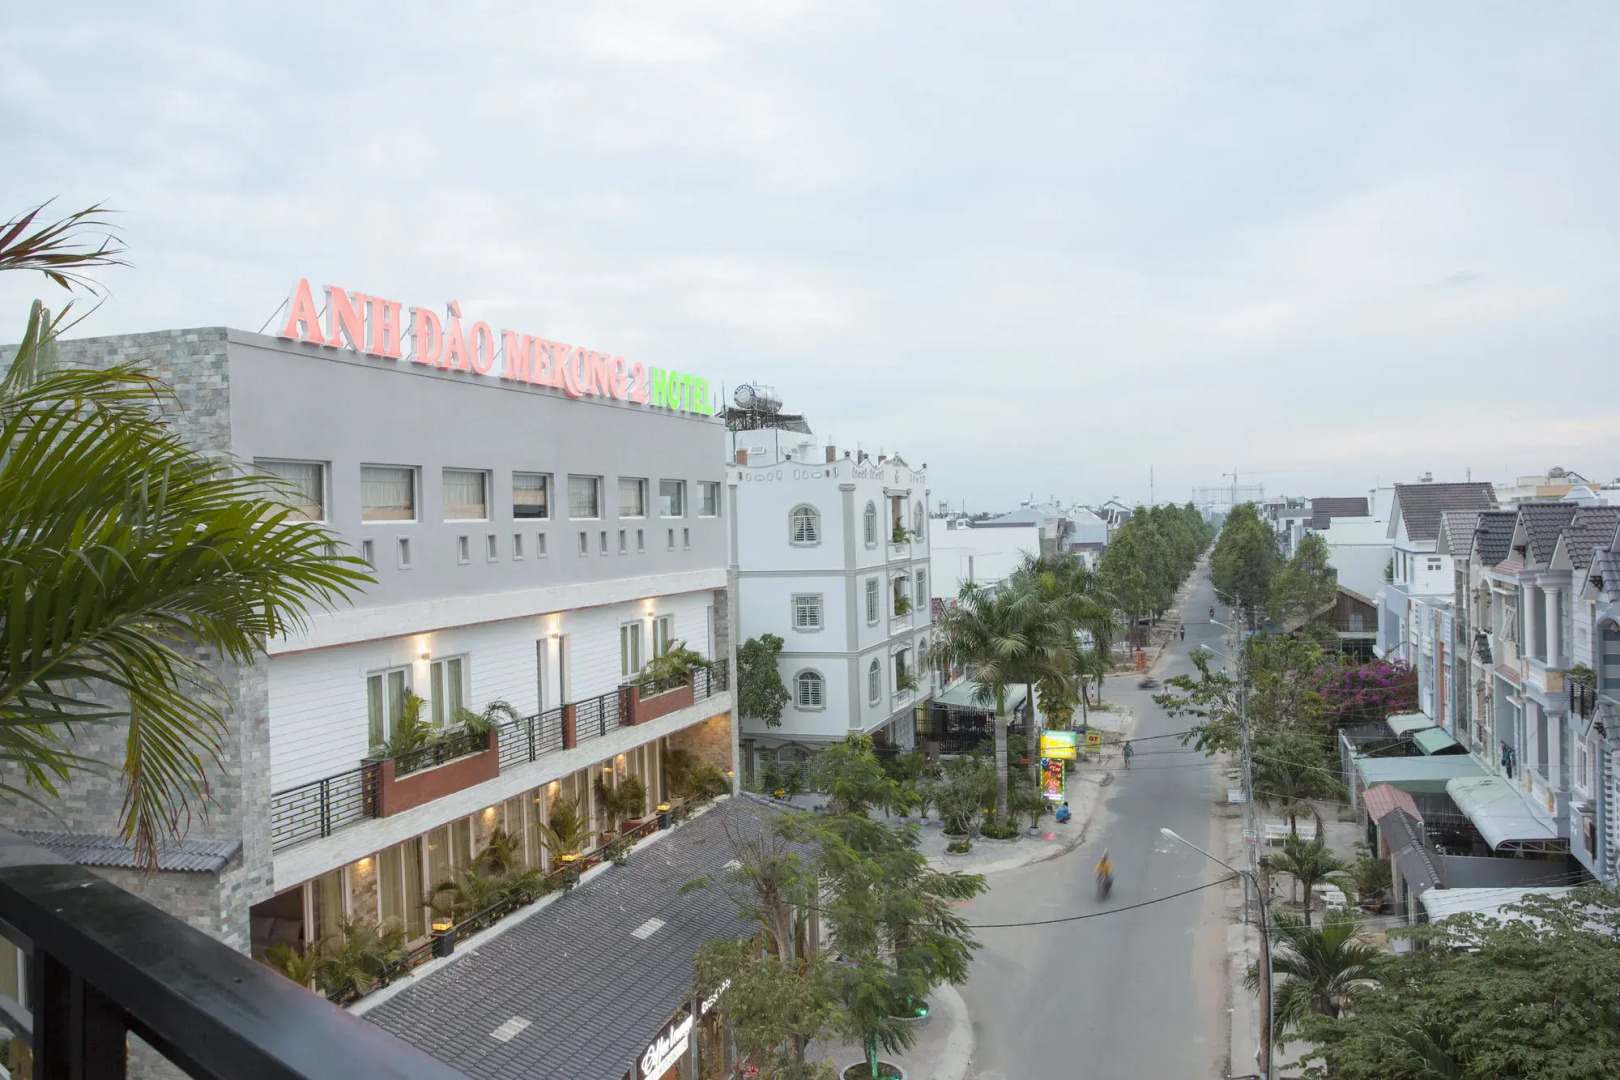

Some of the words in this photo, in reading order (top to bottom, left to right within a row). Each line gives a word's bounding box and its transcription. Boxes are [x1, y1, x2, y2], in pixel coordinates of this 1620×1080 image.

[278, 278, 403, 359] ANH
[409, 300, 495, 374] ĐÀO
[501, 329, 628, 399] MEKONG
[628, 361, 648, 405] 2
[648, 366, 714, 415] HOTEL
